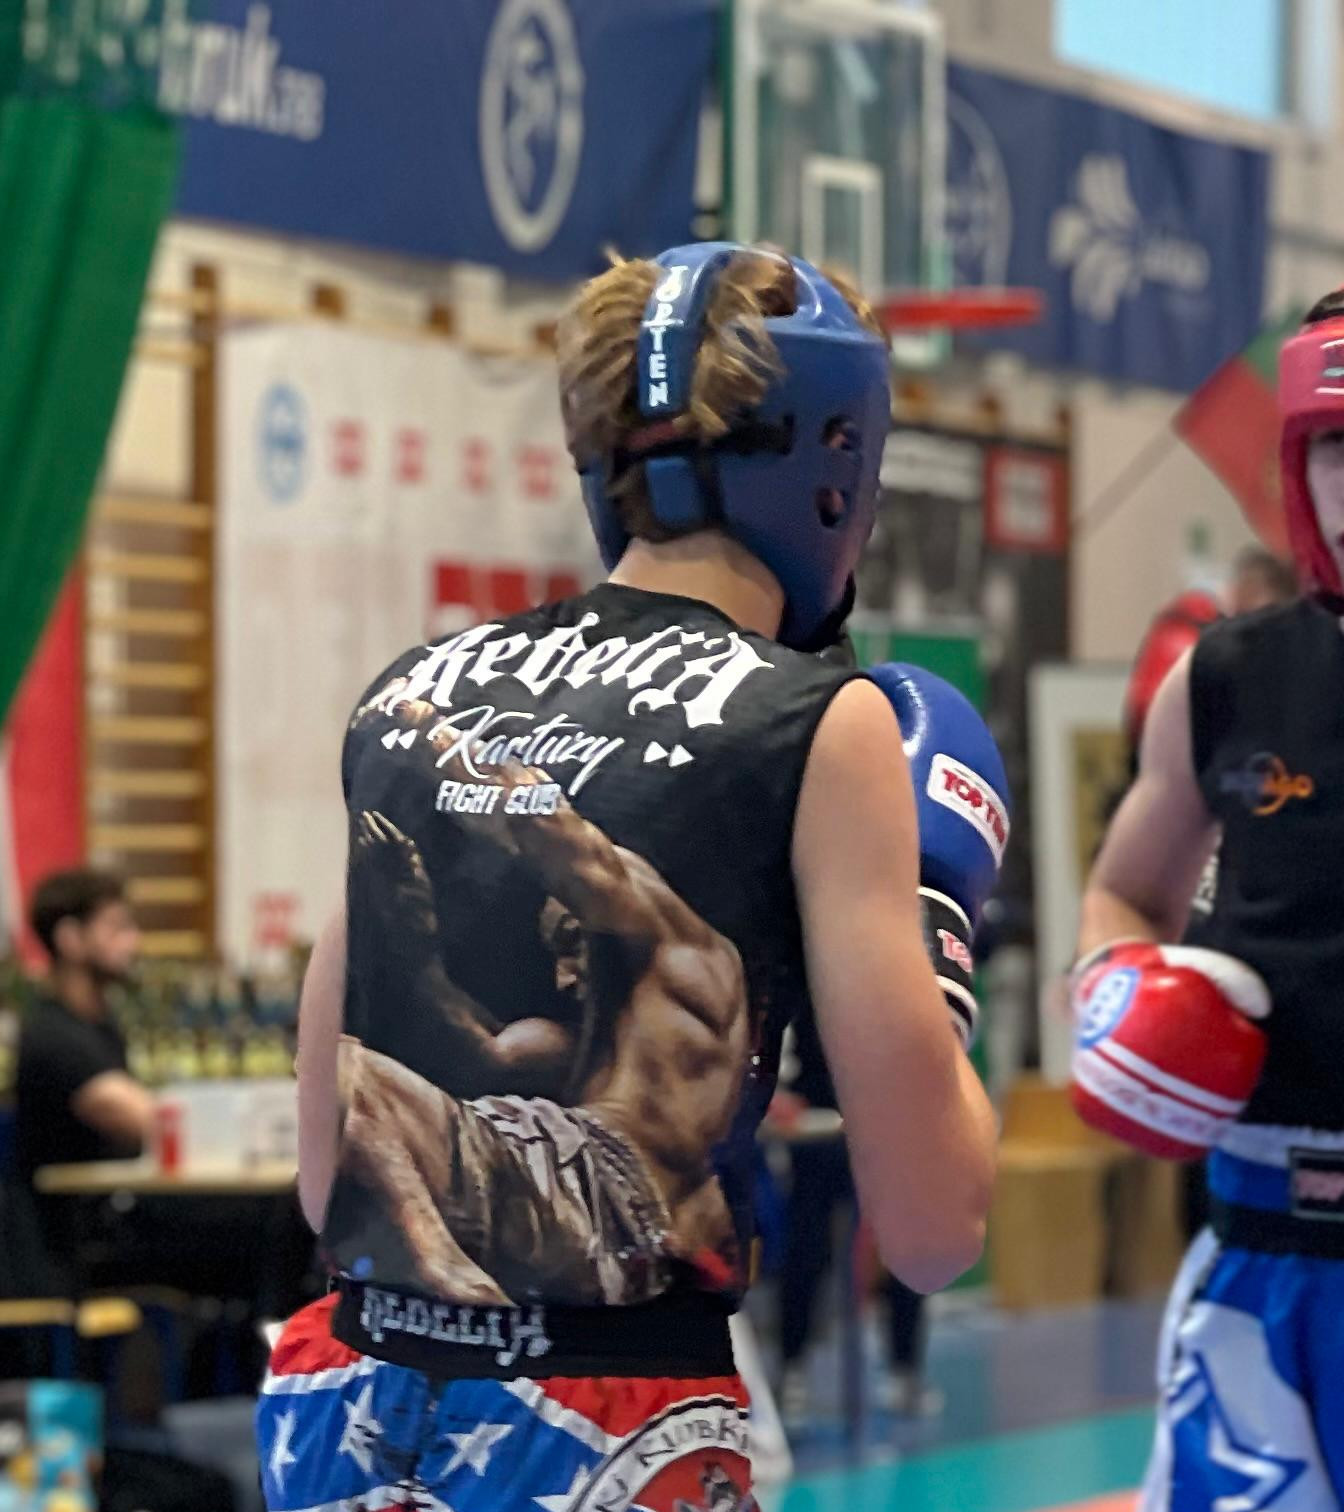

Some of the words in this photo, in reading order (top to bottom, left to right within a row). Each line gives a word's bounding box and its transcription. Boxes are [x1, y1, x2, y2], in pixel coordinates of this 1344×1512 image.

[427, 704, 625, 796] Kartuzy
[435, 779, 503, 814] FIGHT
[504, 783, 561, 815] CLUB
